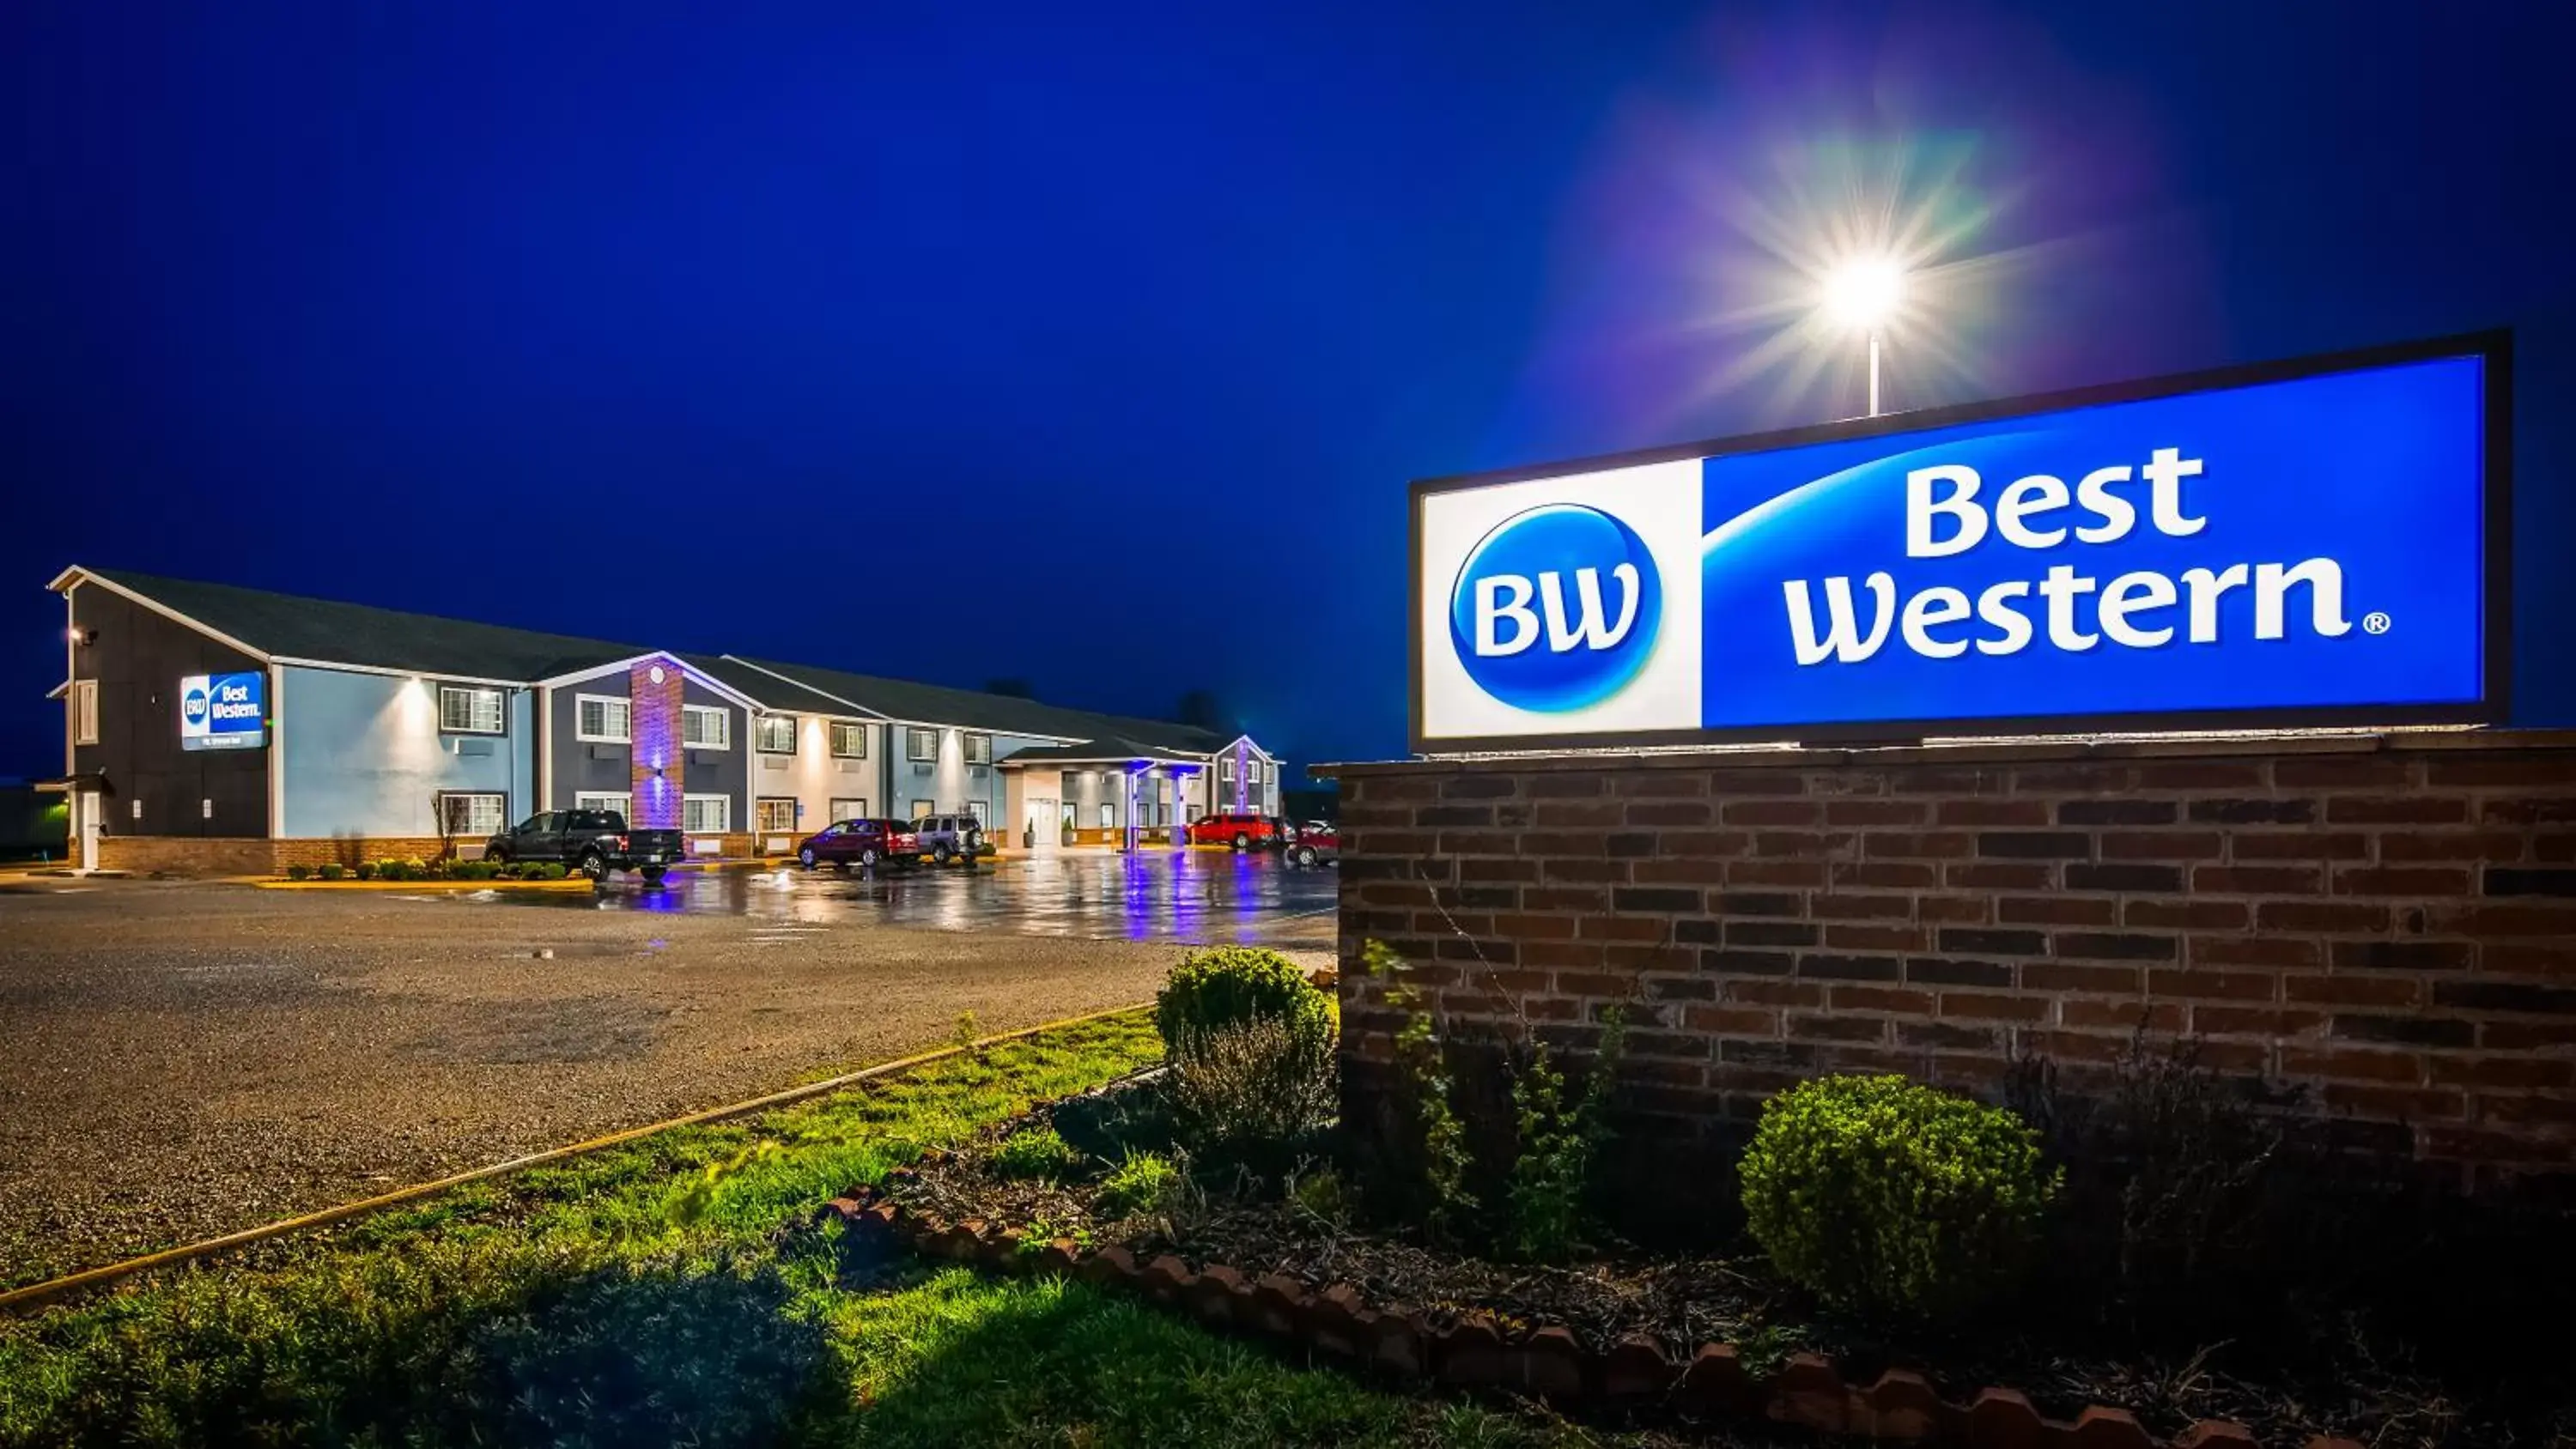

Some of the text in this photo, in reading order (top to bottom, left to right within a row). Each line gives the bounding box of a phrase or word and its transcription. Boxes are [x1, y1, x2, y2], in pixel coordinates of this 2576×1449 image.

[1907, 447, 2207, 557] Best
[1474, 562, 1640, 657] BW
[186, 699, 205, 714] BW
[222, 686, 247, 701] Best
